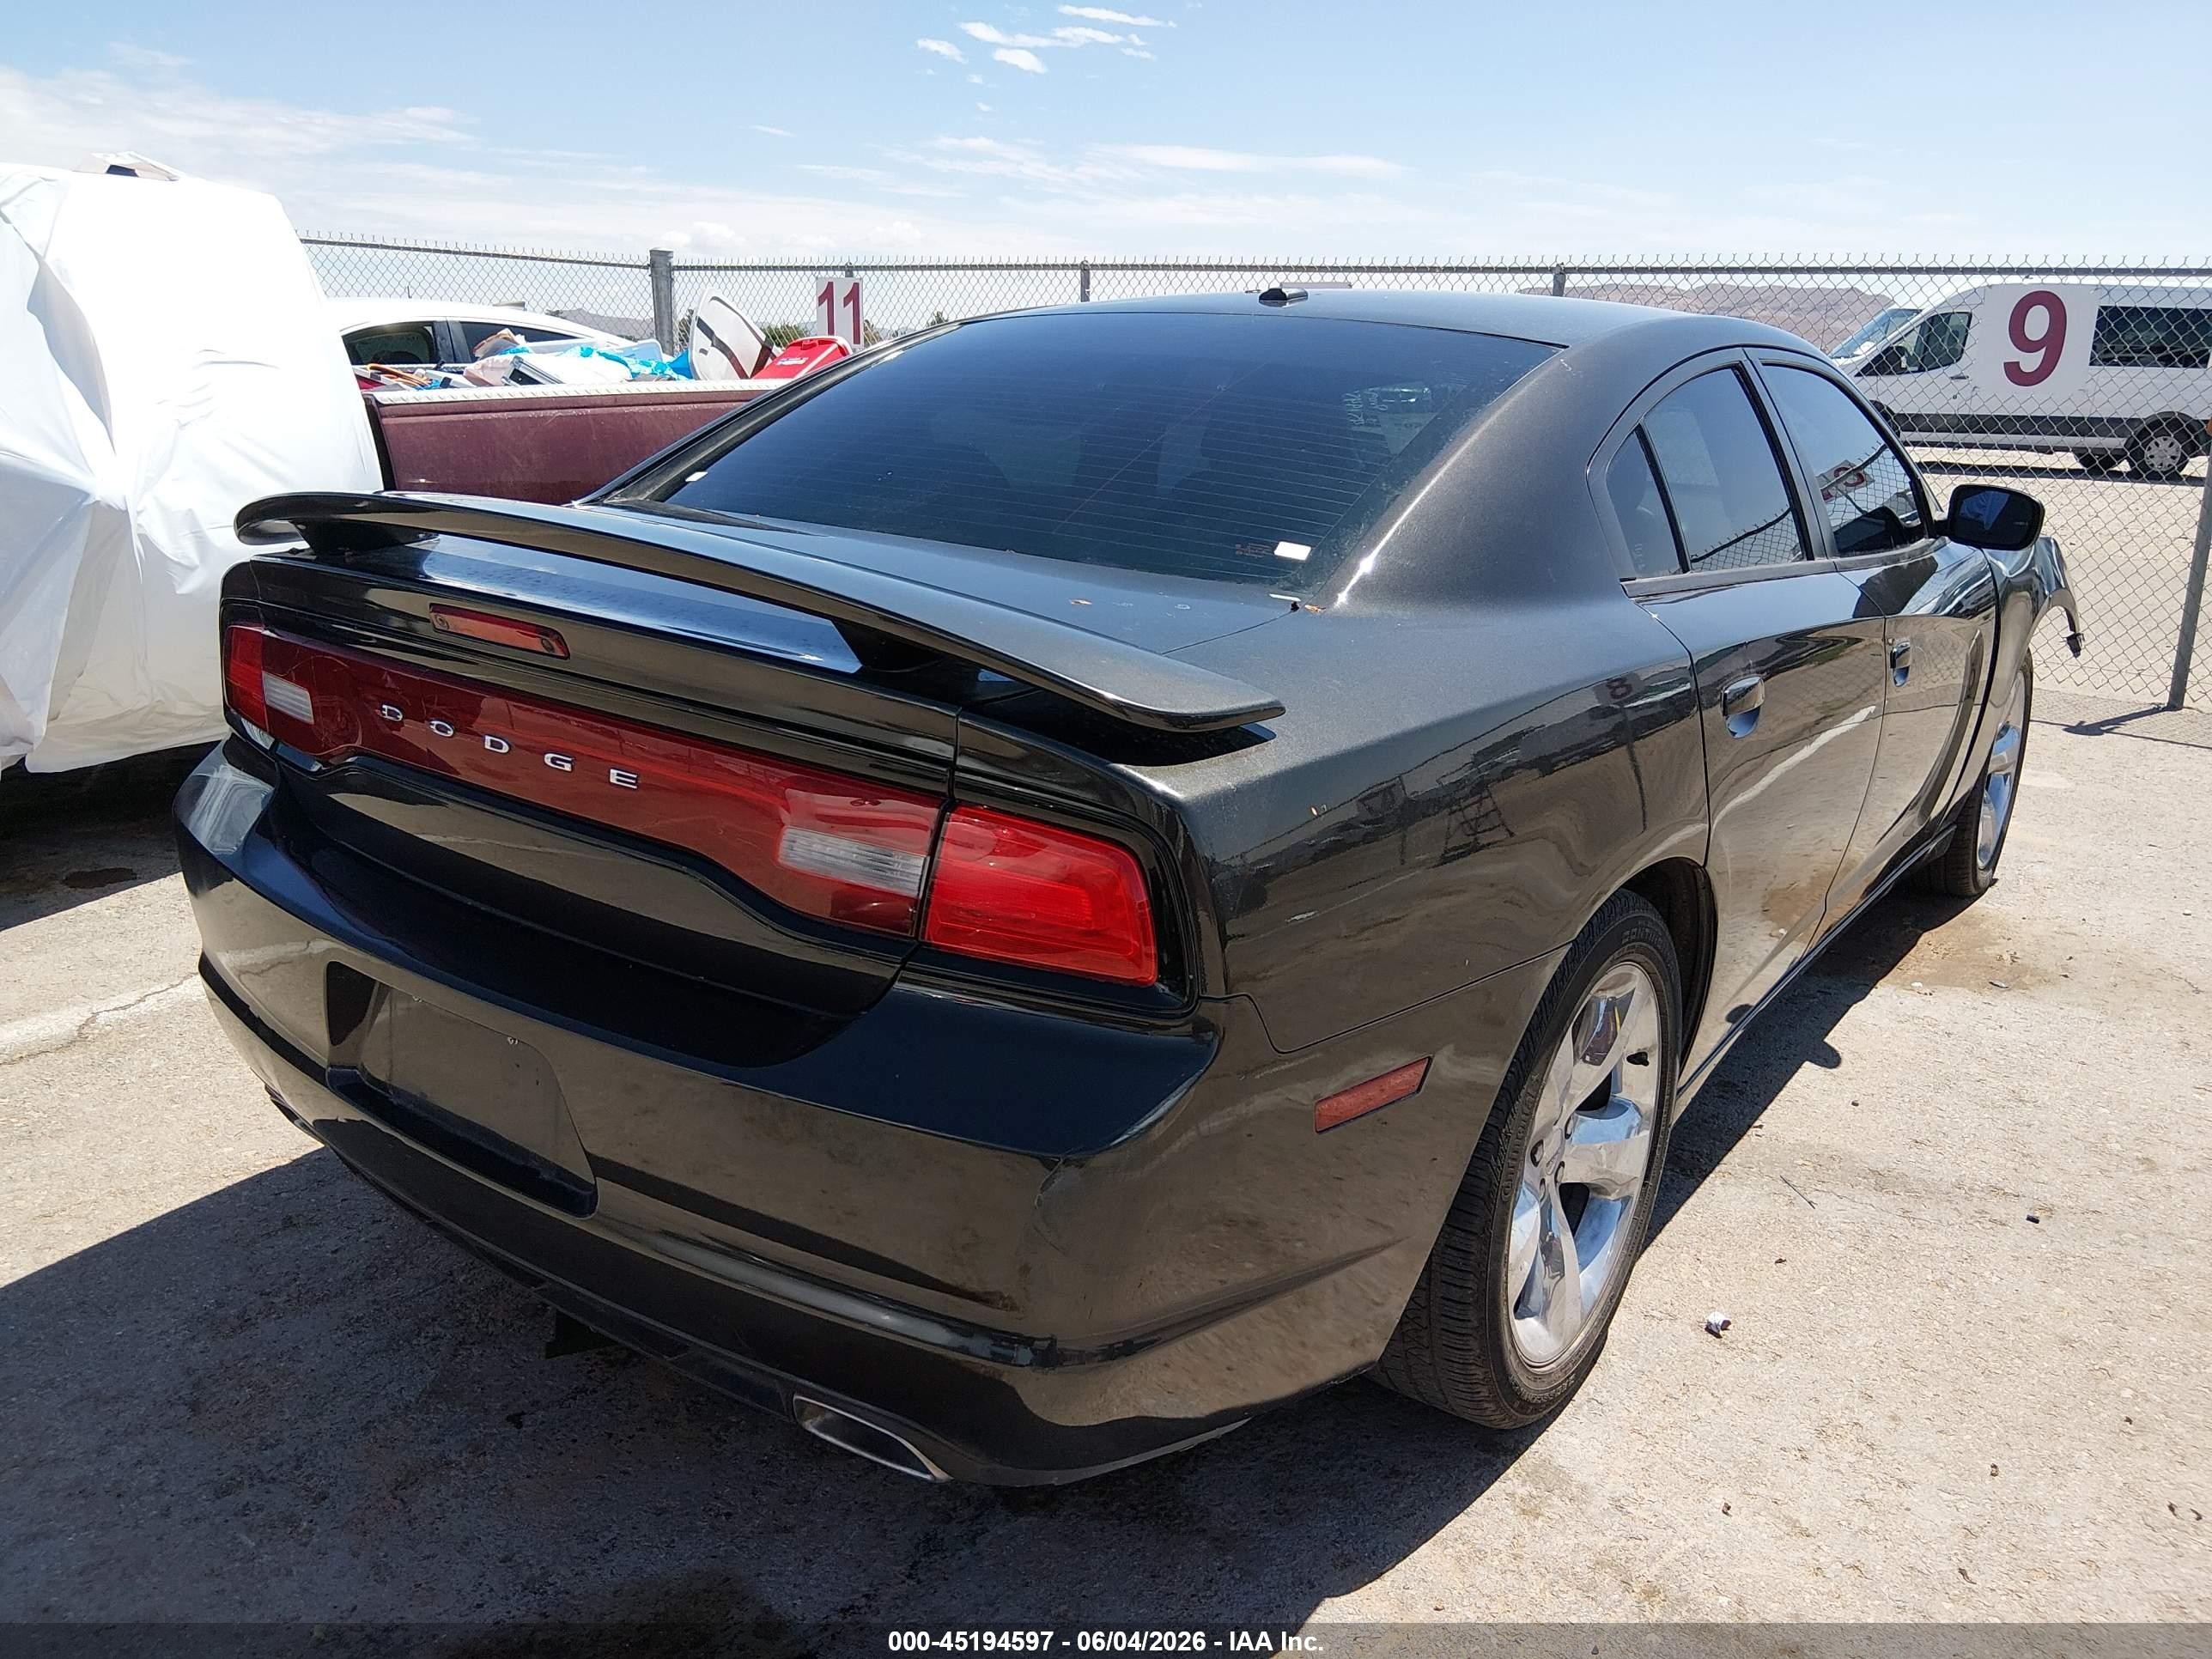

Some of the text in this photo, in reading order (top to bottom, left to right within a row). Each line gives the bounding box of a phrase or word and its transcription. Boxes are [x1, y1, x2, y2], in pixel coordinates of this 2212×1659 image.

[817, 281, 861, 345] 11
[2002, 289, 2068, 387] 9
[380, 704, 639, 790] DODGE
